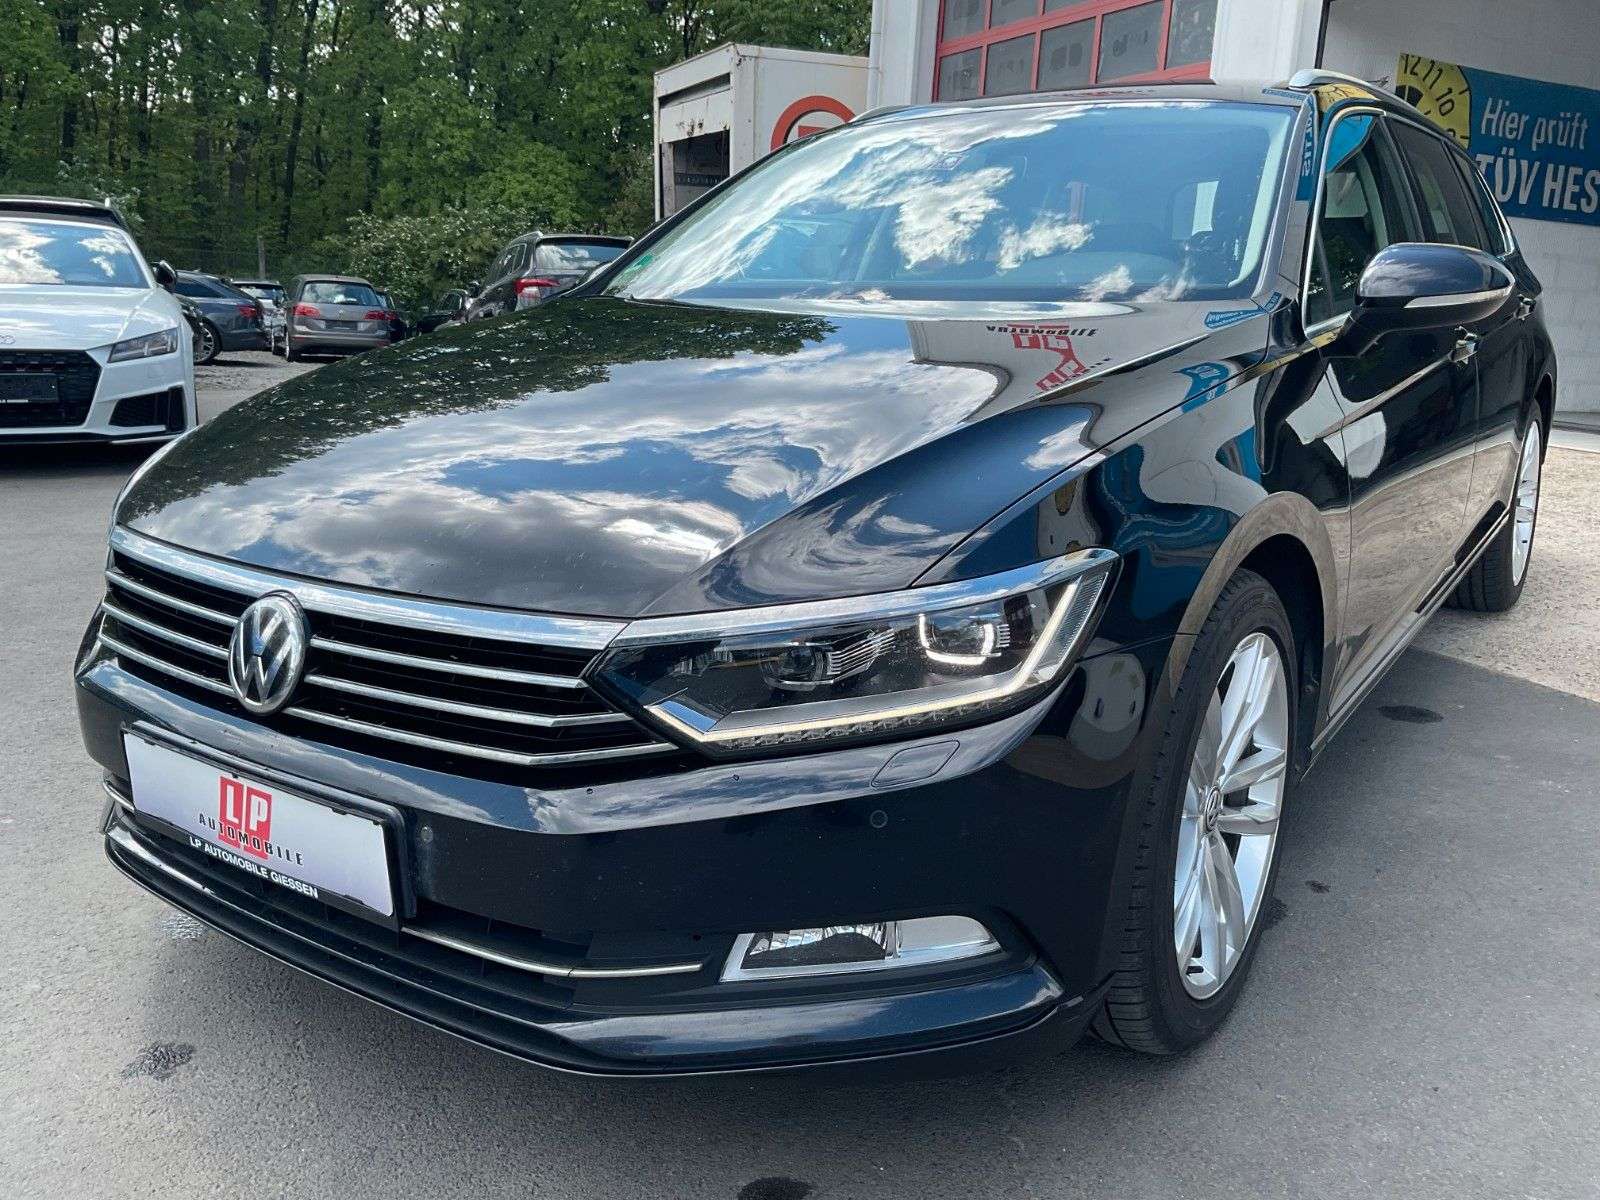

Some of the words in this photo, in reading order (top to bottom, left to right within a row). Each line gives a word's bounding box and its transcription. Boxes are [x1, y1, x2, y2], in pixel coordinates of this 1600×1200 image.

[1402, 53, 1422, 77] 12
[1422, 59, 1444, 90] 11
[1436, 87, 1455, 117] 10
[1481, 98, 1530, 139] Hier
[1531, 111, 1589, 151] prüft
[1475, 147, 1541, 204] TÜV
[221, 779, 271, 834] LP
[199, 812, 304, 866] AUTOMOBILE
[189, 835, 202, 848] LP
[204, 842, 268, 878] AUTOMOBILE
[271, 872, 318, 898] GIESSEN
